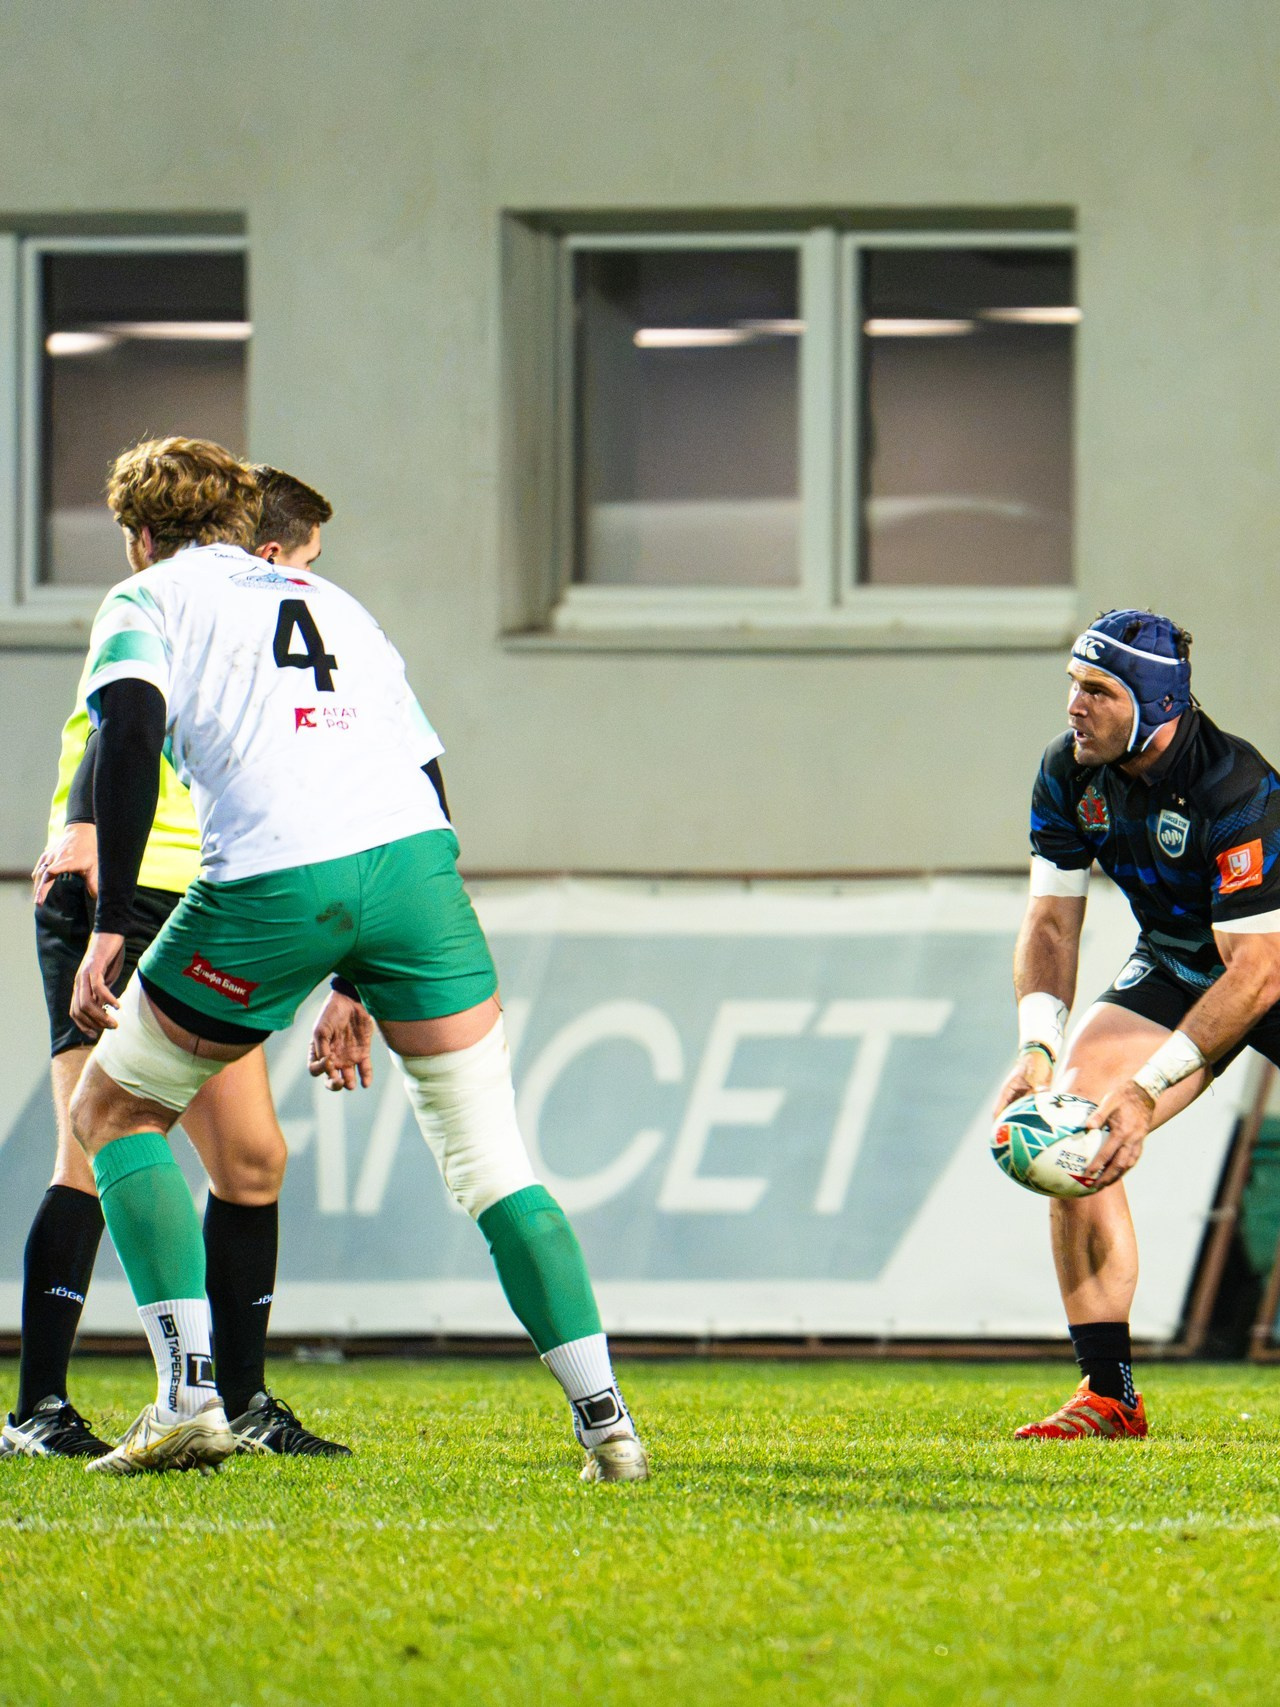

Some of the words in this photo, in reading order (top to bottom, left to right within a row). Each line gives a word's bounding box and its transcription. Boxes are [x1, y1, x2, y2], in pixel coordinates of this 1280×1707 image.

[273, 599, 338, 692] 4
[222, 978, 247, 996] Банк
[168, 1338, 182, 1413] TAPEDESIGN
